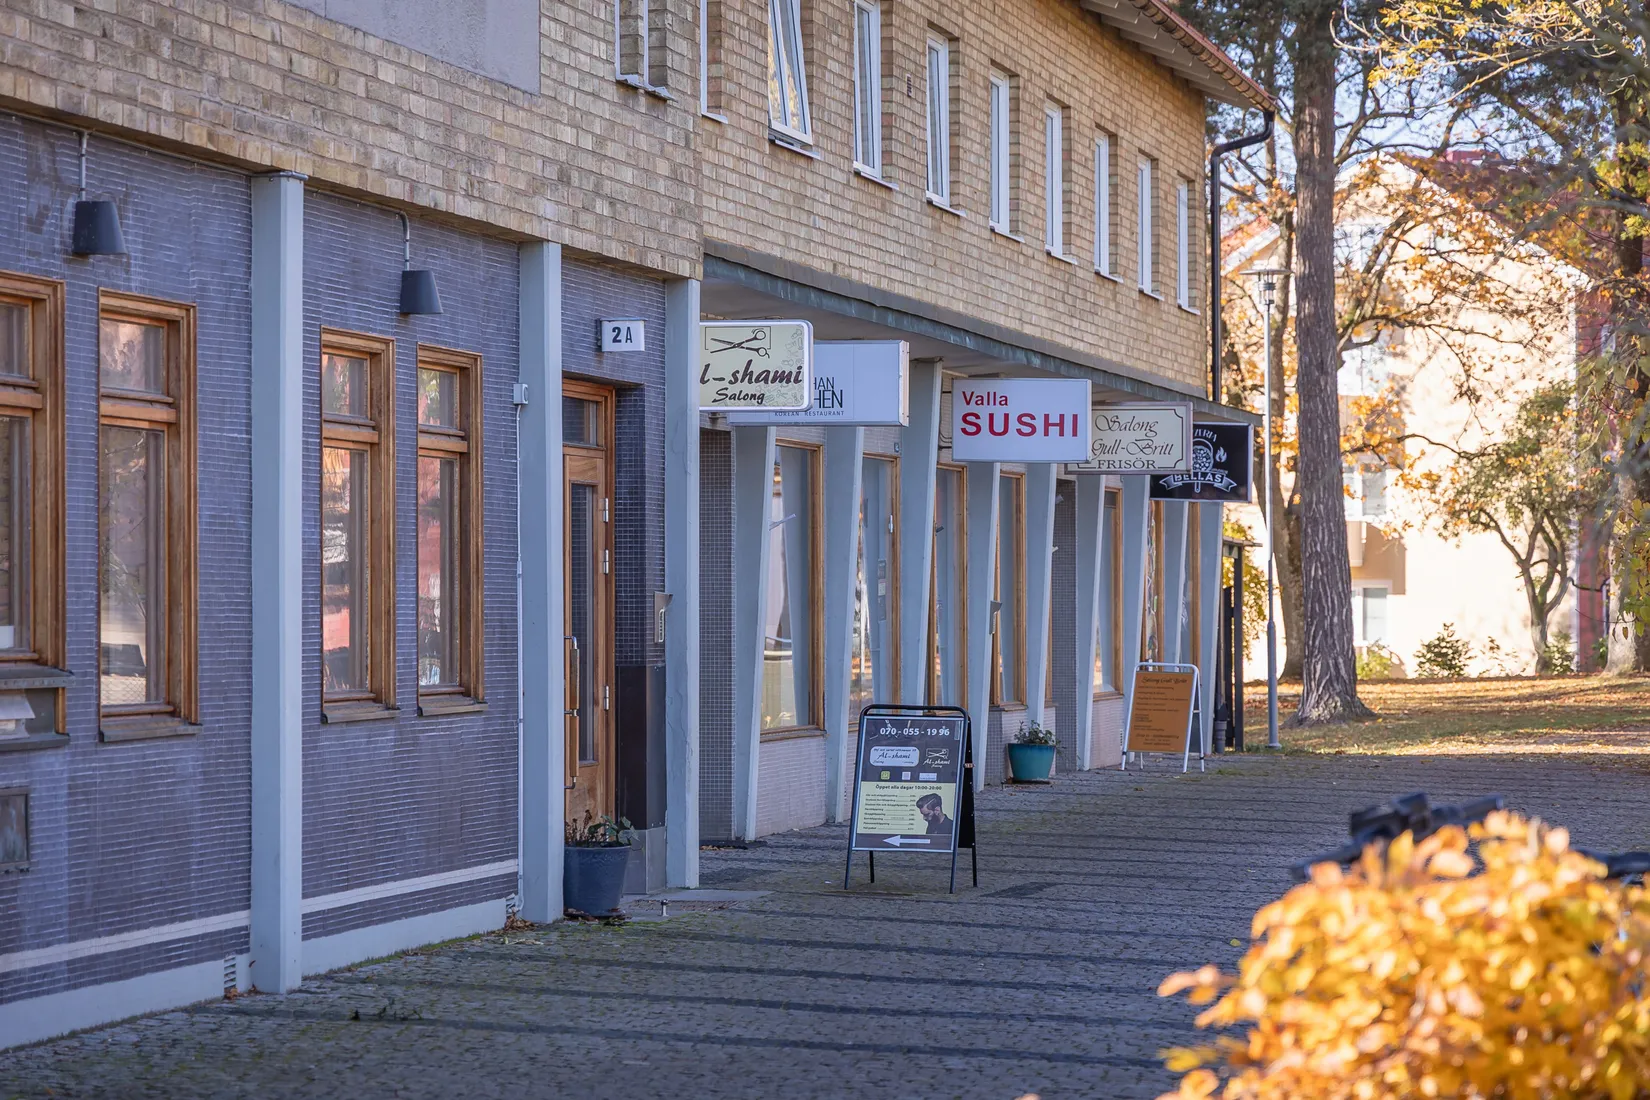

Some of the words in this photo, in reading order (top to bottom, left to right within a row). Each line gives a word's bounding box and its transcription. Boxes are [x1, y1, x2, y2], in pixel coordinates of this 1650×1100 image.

[711, 387, 766, 405] Salong
[962, 391, 1009, 406] Valla
[960, 412, 1078, 437] SUSHI
[1094, 414, 1159, 438] Salong
[1091, 438, 1174, 461] Gull-Britt
[1097, 457, 1157, 470] FRISÖR
[1173, 472, 1222, 483] BELLAS
[880, 727, 897, 735] 070
[903, 728, 920, 736] 055
